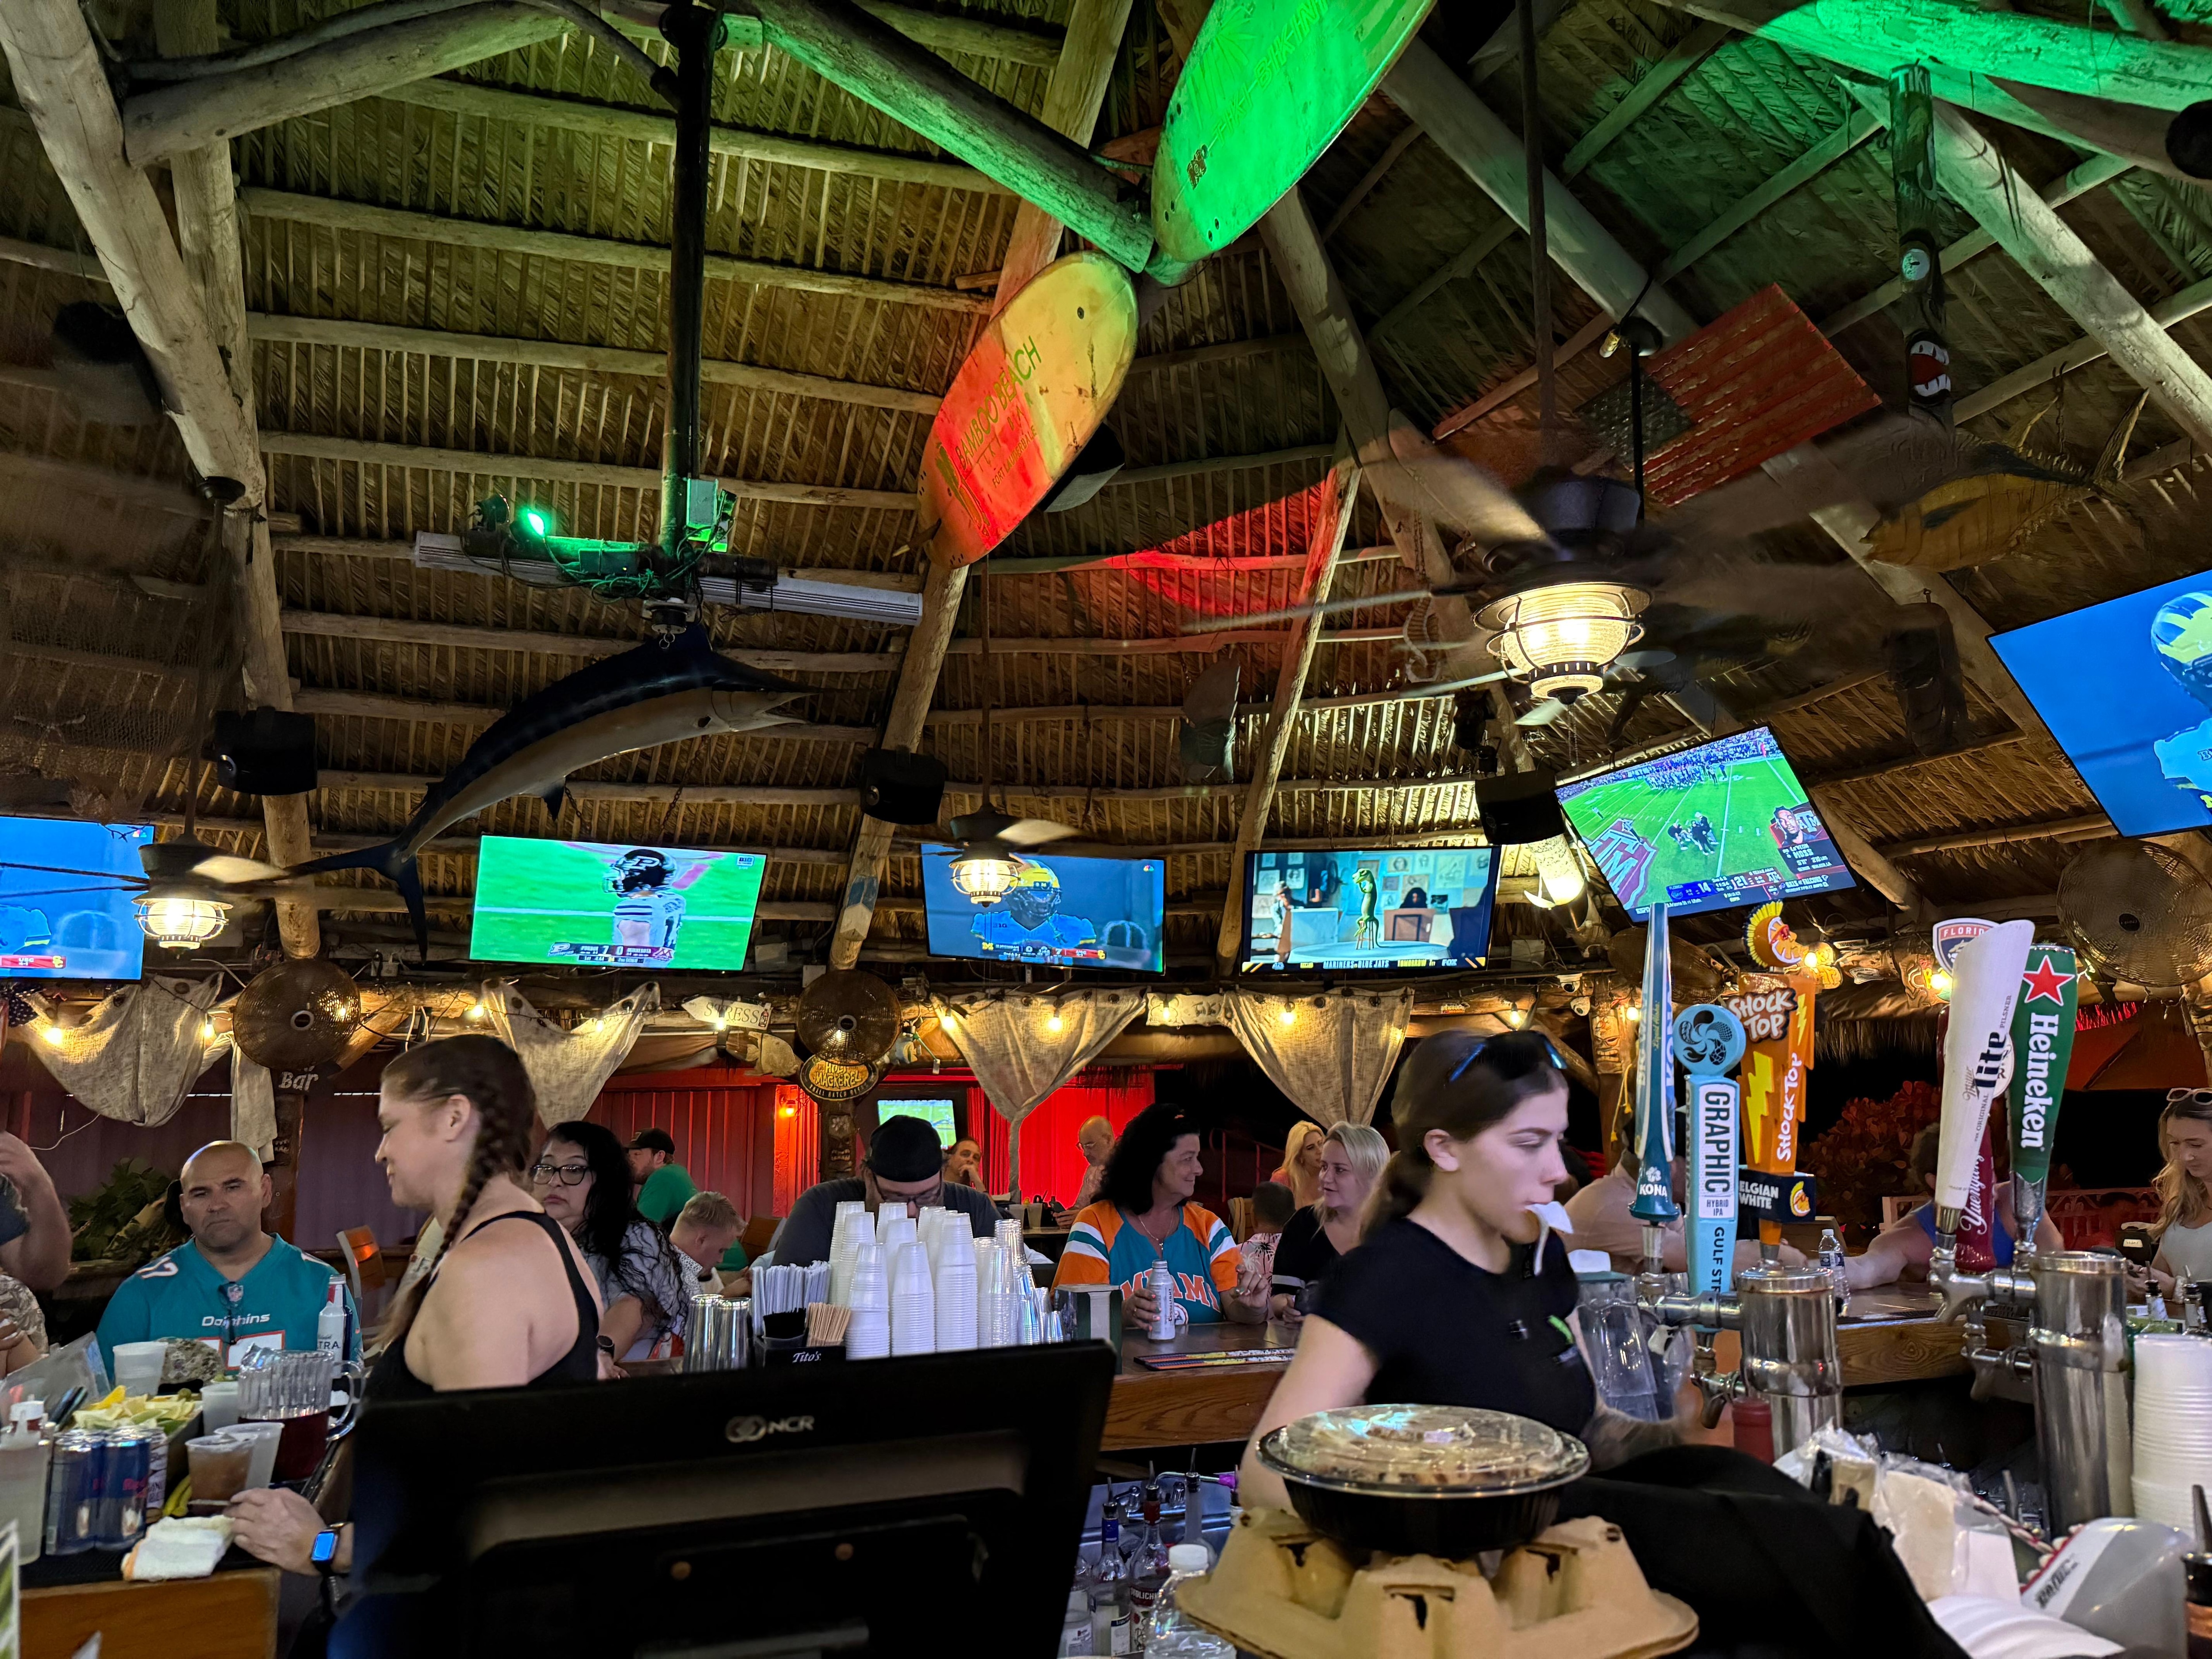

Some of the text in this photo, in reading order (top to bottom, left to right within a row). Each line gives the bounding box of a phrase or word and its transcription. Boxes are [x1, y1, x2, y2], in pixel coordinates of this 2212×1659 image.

[955, 335, 1042, 471] BAMBOO BEACH
[992, 425, 1037, 488] FORT LAUDERDALE
[1792, 849, 1814, 859] MOSS
[1697, 882, 1712, 893] 14
[1734, 875, 1748, 887] 21
[1943, 927, 1985, 937] FLORID
[602, 945, 610, 955] 7
[617, 946, 624, 955] 0
[1323, 960, 1355, 969] MARINERS
[1358, 960, 1373, 968] BLUE
[1373, 960, 1390, 968] JAYS
[1729, 990, 1793, 1020] SHOCK
[2000, 995, 2012, 1029] PILSNER
[1743, 1013, 1785, 1039] TOP
[279, 1067, 319, 1091] Bar
[815, 1070, 862, 1090] MACKEREL
[1962, 1066, 1977, 1102] Miller
[2020, 1012, 2059, 1149] Heineken
[1777, 1052, 1802, 1162] SHOCK TOP
[1976, 1093, 1989, 1133] ORIGINAL
[1705, 1091, 1731, 1193] GRAPHIC
[1639, 1183, 1667, 1197] KONA
[1739, 1180, 1779, 1199] ELGIAN
[1960, 1153, 1987, 1235] Yueng
[1707, 1198, 1729, 1209] HYBRID
[1739, 1192, 1772, 1210] WHITE
[1713, 1207, 1724, 1217] IPA
[1710, 1226, 1724, 1292] GULF STR
[202, 1313, 271, 1327] Dohins
[318, 1340, 341, 1350] TRA
[792, 1351, 821, 1364] Tito's
[764, 1416, 814, 1433] NCR
